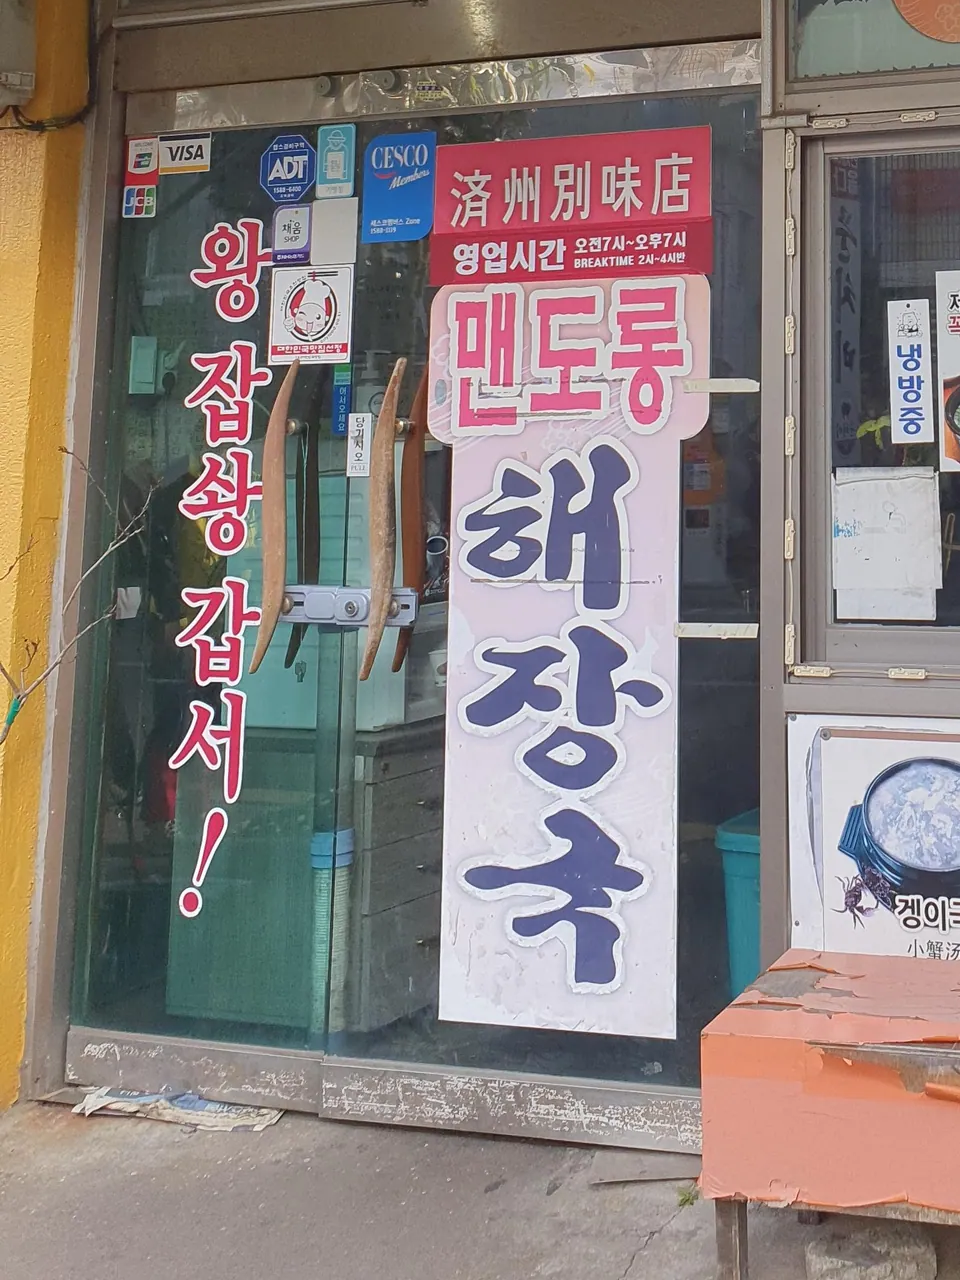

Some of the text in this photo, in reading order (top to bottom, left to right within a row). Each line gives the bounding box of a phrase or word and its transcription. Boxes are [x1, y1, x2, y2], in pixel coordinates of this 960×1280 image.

[166, 144, 204, 161] VISA
[268, 155, 308, 181] ADT
[371, 143, 428, 169] CESCO
[388, 168, 430, 190] Members
[450, 152, 693, 228] 済州別味店
[282, 221, 302, 235] 채움
[191, 219, 273, 321] 왕
[453, 231, 687, 276] 영업시간 오전7시~오후7시
[574, 255, 634, 269] BREAKTIME
[454, 286, 684, 428] 맨도롱
[338, 387, 347, 431] 어서오세요
[897, 343, 924, 436] 냉방중
[354, 417, 366, 462] 당기시오
[464, 448, 663, 984] 해장국
